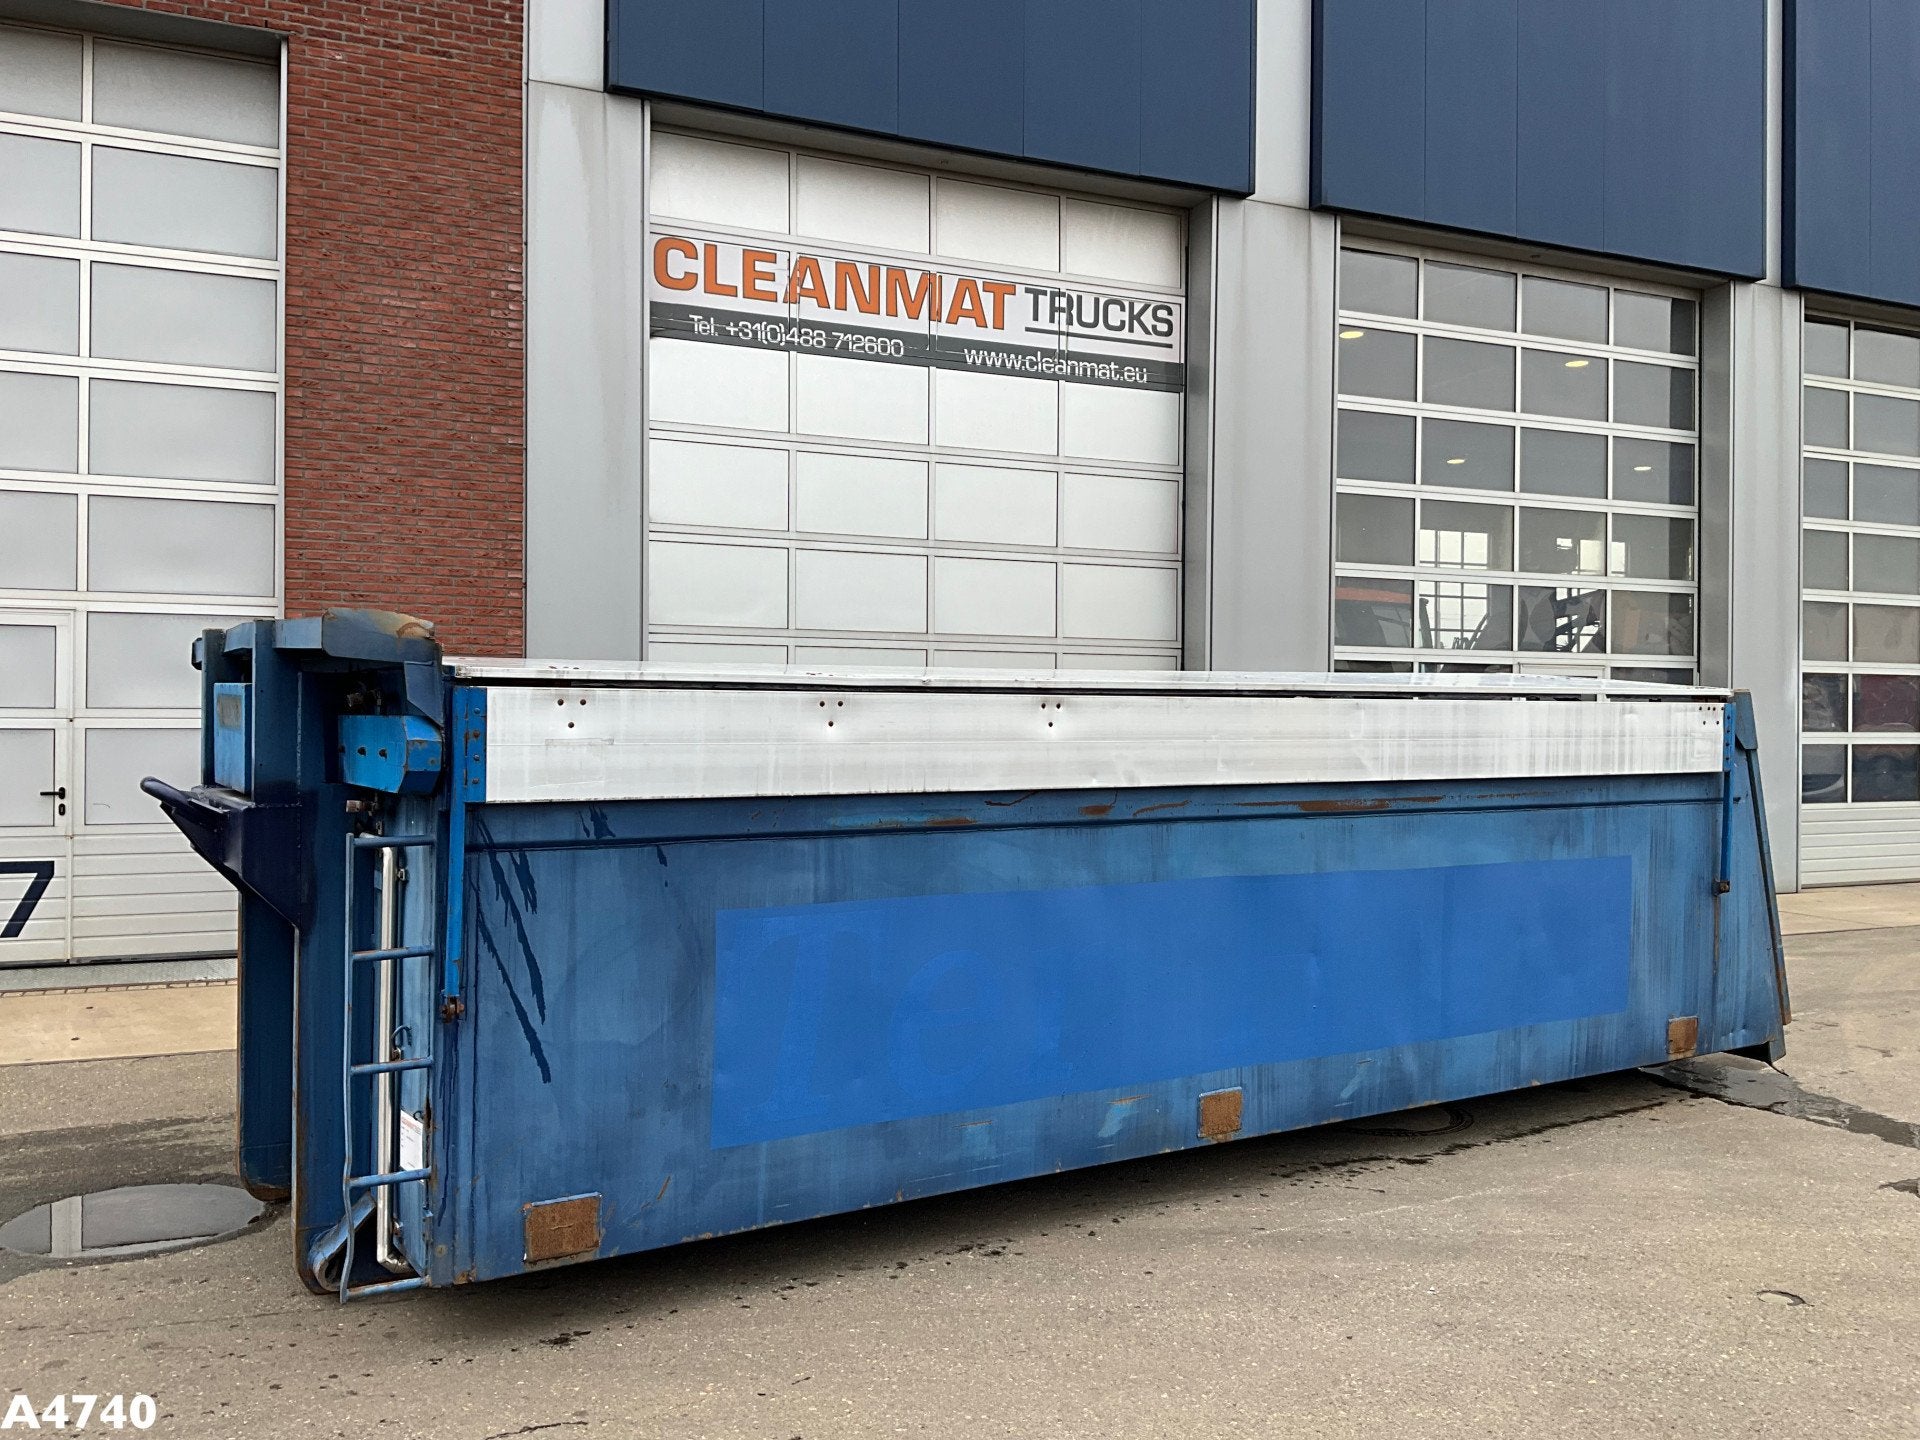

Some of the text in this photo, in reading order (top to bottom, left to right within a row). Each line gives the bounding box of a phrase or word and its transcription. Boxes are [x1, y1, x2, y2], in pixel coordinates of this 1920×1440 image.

[652, 236, 1174, 338] CLEANMAT TRUCKS
[688, 314, 905, 358] Tel. +31(0)488 712600
[963, 348, 1148, 384] www.cleanmat.eu
[0, 860, 55, 938] 7
